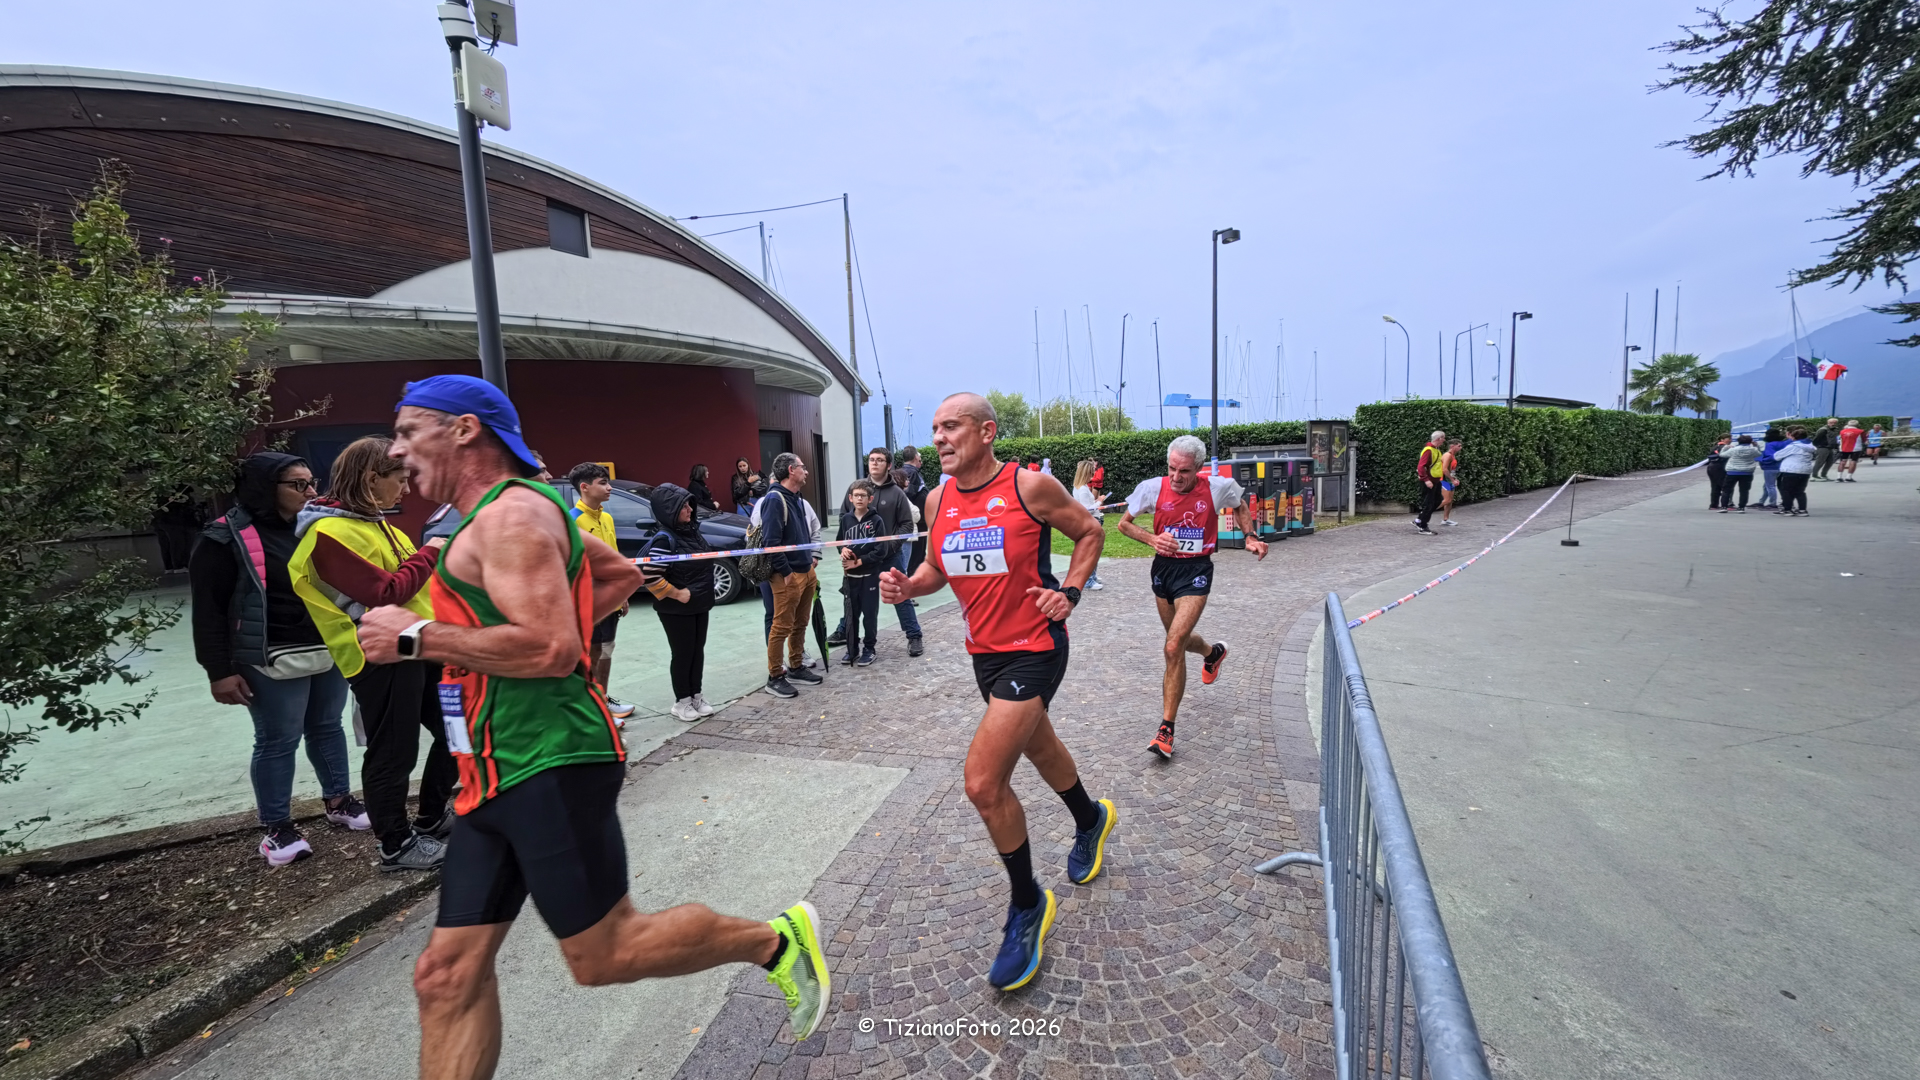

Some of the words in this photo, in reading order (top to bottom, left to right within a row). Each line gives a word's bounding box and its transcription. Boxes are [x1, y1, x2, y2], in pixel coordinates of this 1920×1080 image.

[844, 520, 876, 541] NIKE
[1177, 540, 1194, 551] 72
[961, 553, 986, 572] 78
